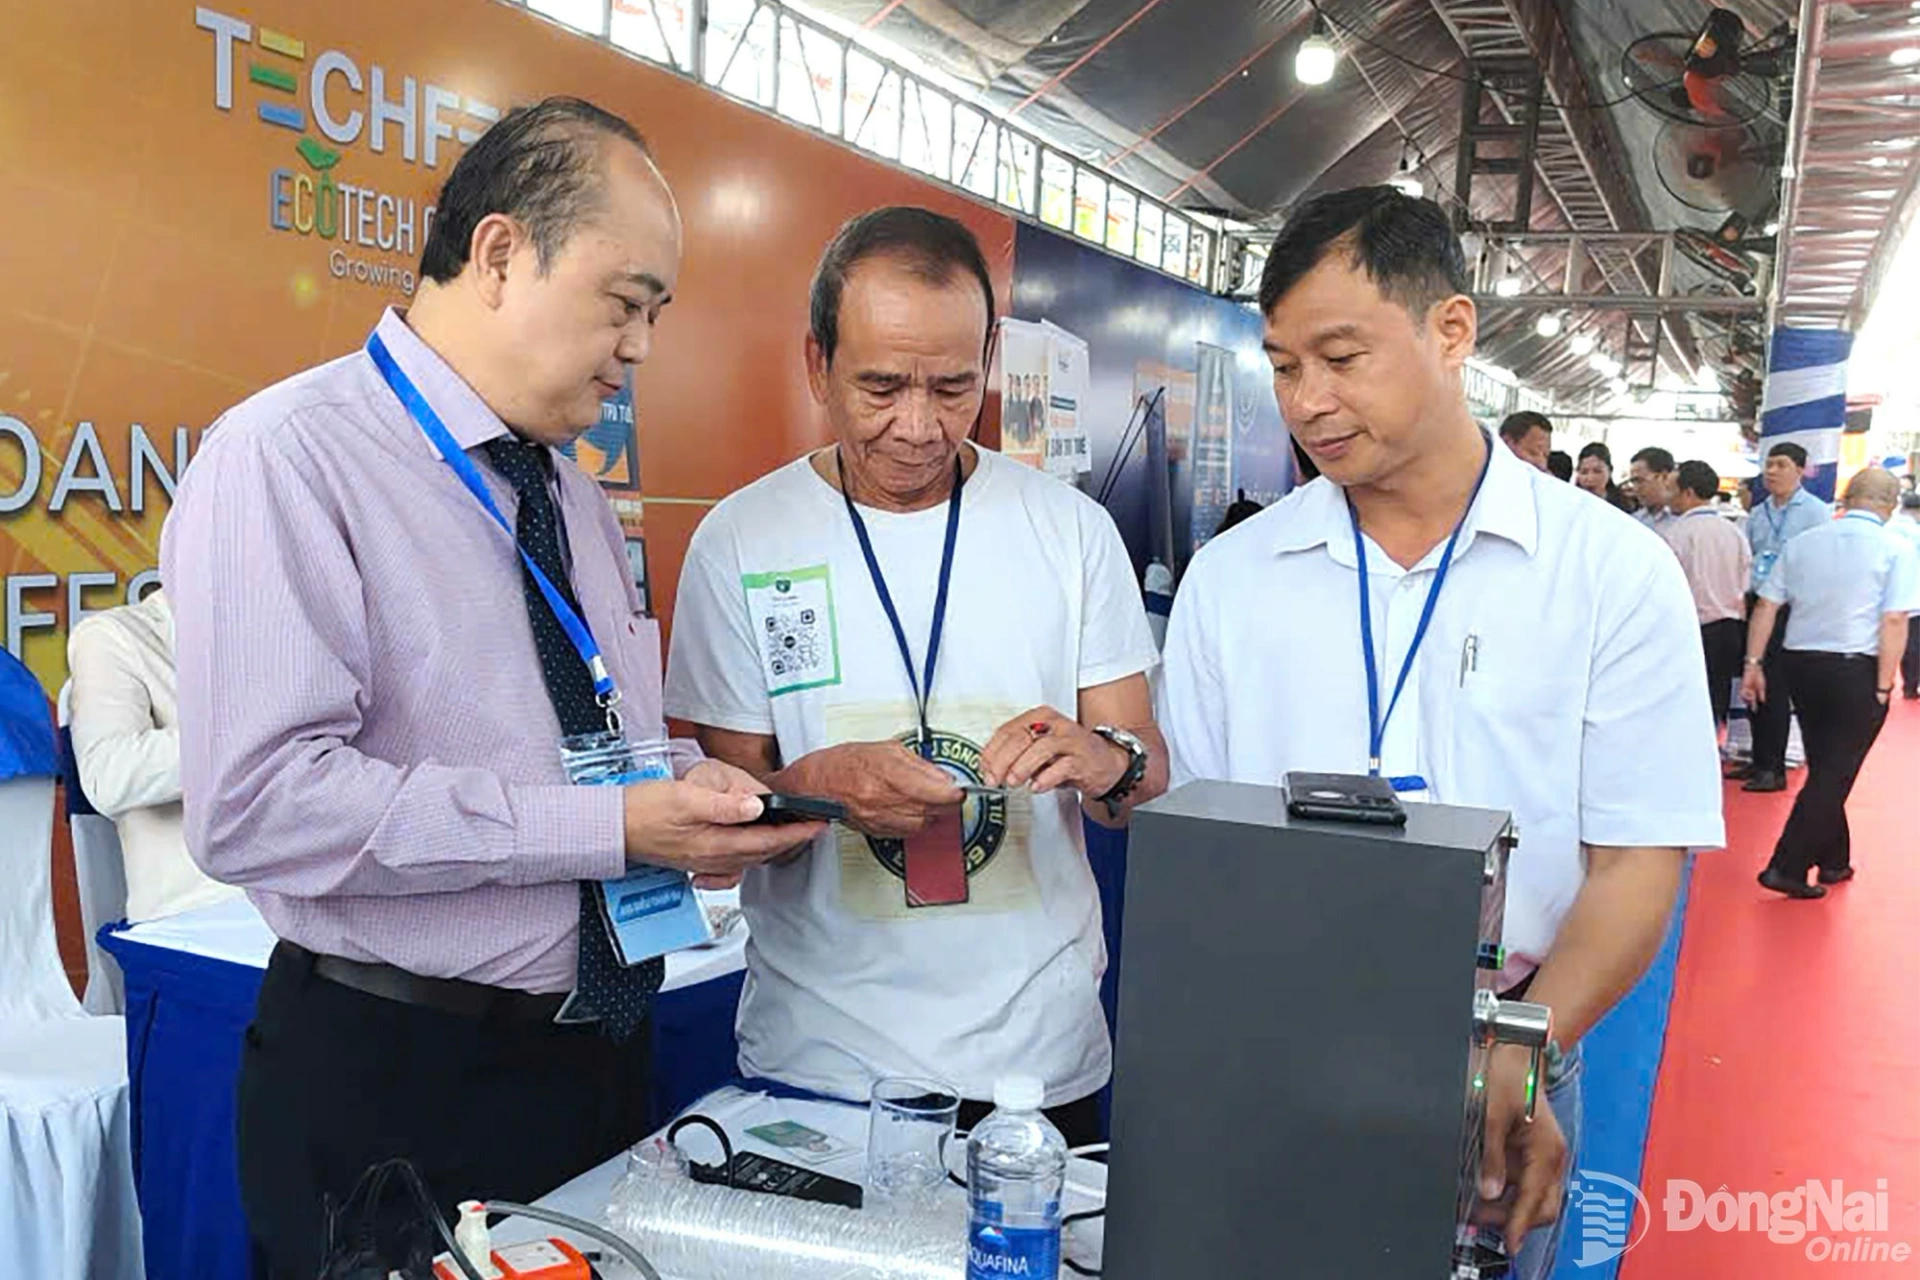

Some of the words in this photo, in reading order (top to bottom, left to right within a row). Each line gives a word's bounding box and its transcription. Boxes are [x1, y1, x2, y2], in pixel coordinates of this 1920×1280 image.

[272, 168, 414, 254] ECOTECH
[330, 250, 414, 295] Growing
[968, 1246, 1032, 1278] QUAFINA
